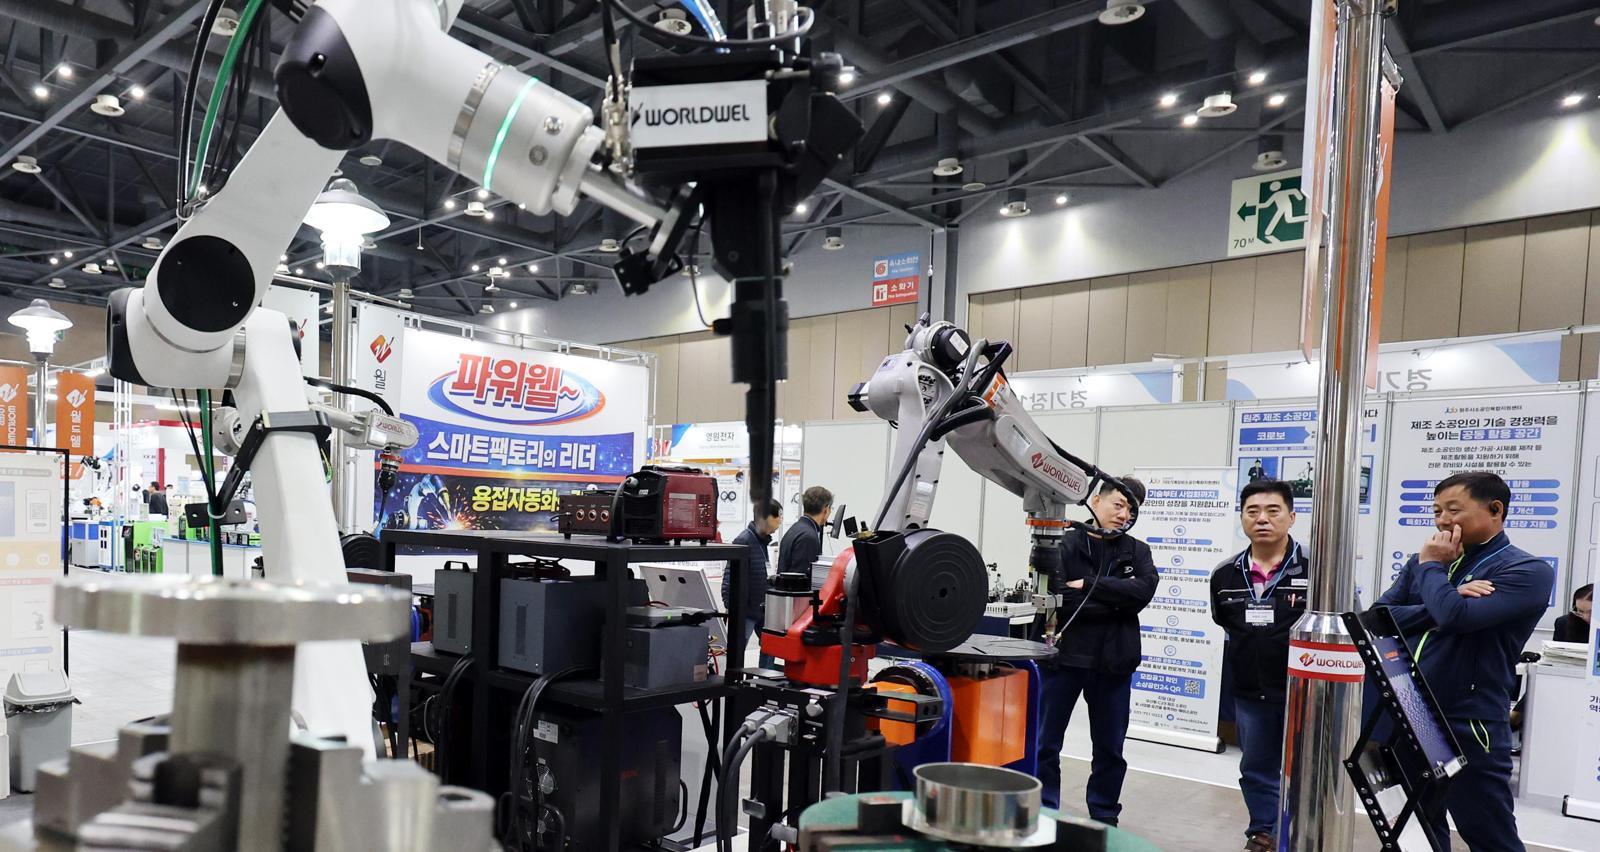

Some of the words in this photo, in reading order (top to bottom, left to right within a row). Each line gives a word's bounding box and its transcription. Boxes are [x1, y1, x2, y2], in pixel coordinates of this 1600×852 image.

[645, 103, 750, 127] WORLDWEL
[1233, 238, 1247, 249] 70
[890, 281, 915, 292] 소화기
[1263, 412, 1281, 421] 제조
[1283, 411, 1312, 421] 소공인
[1410, 420, 1432, 430] 제조
[1435, 418, 1480, 429] 소공인의
[1483, 416, 1506, 427] 기술
[1509, 415, 1558, 426] 경쟁력을
[705, 431, 735, 442] 영원전자
[1426, 431, 1459, 441] 높이는
[1514, 428, 1540, 438] 공간
[427, 432, 556, 469] 스마트팩토리의
[559, 441, 597, 471] 리더
[1042, 462, 1083, 493] WORLDWEL
[471, 485, 560, 513] 용접자동화
[1589, 695, 1600, 703] 기
[1589, 704, 1600, 712] 역
